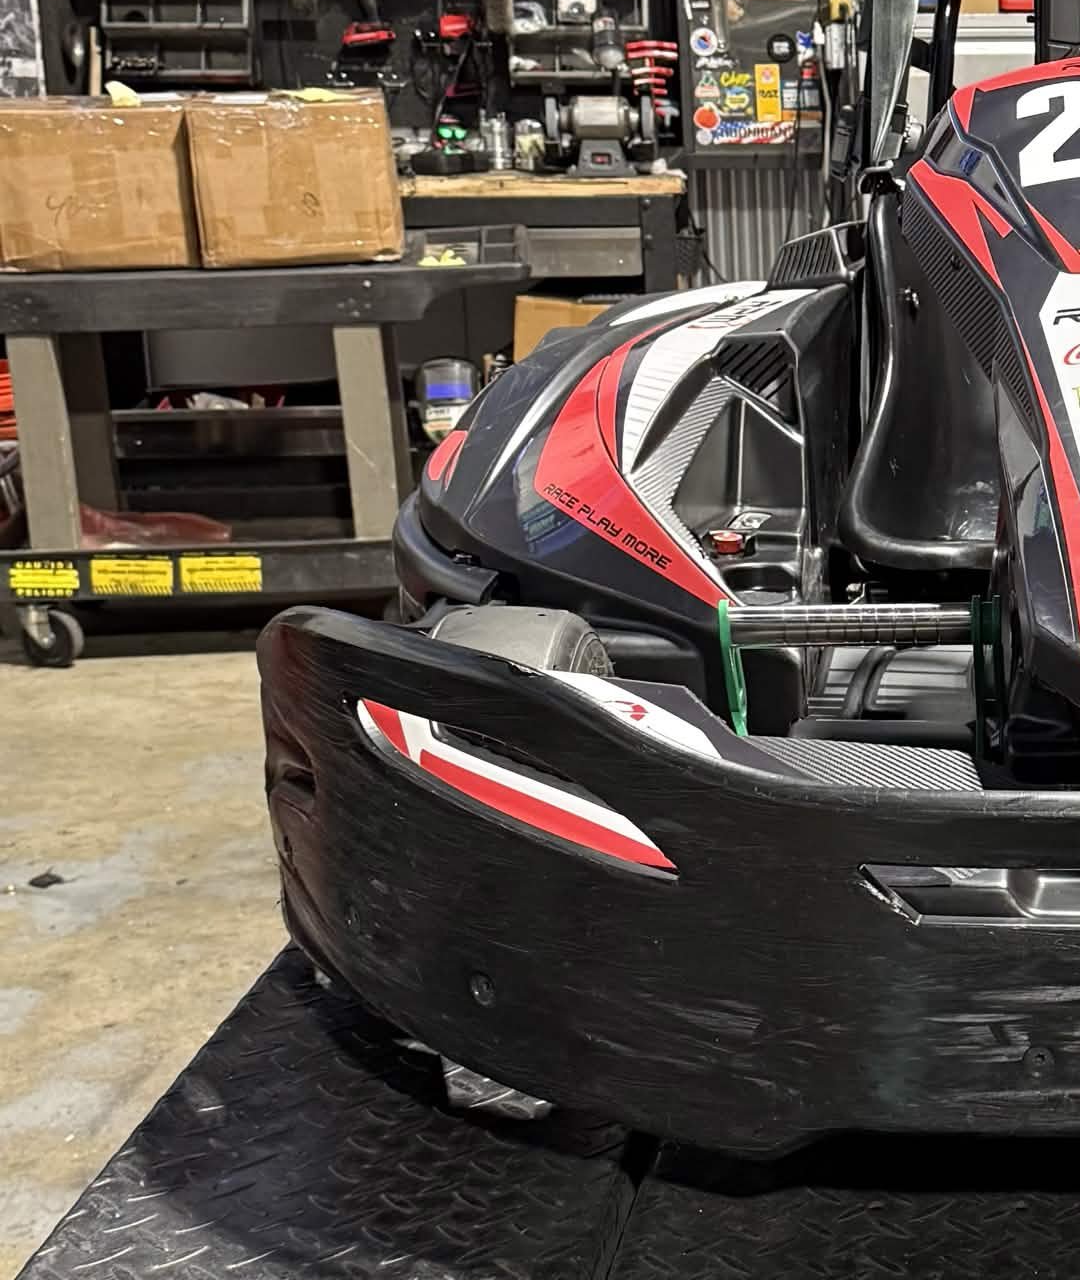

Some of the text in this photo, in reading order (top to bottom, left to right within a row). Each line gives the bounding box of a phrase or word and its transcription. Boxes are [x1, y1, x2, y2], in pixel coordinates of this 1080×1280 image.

[543, 483, 673, 570] RACE PLAY MORE
